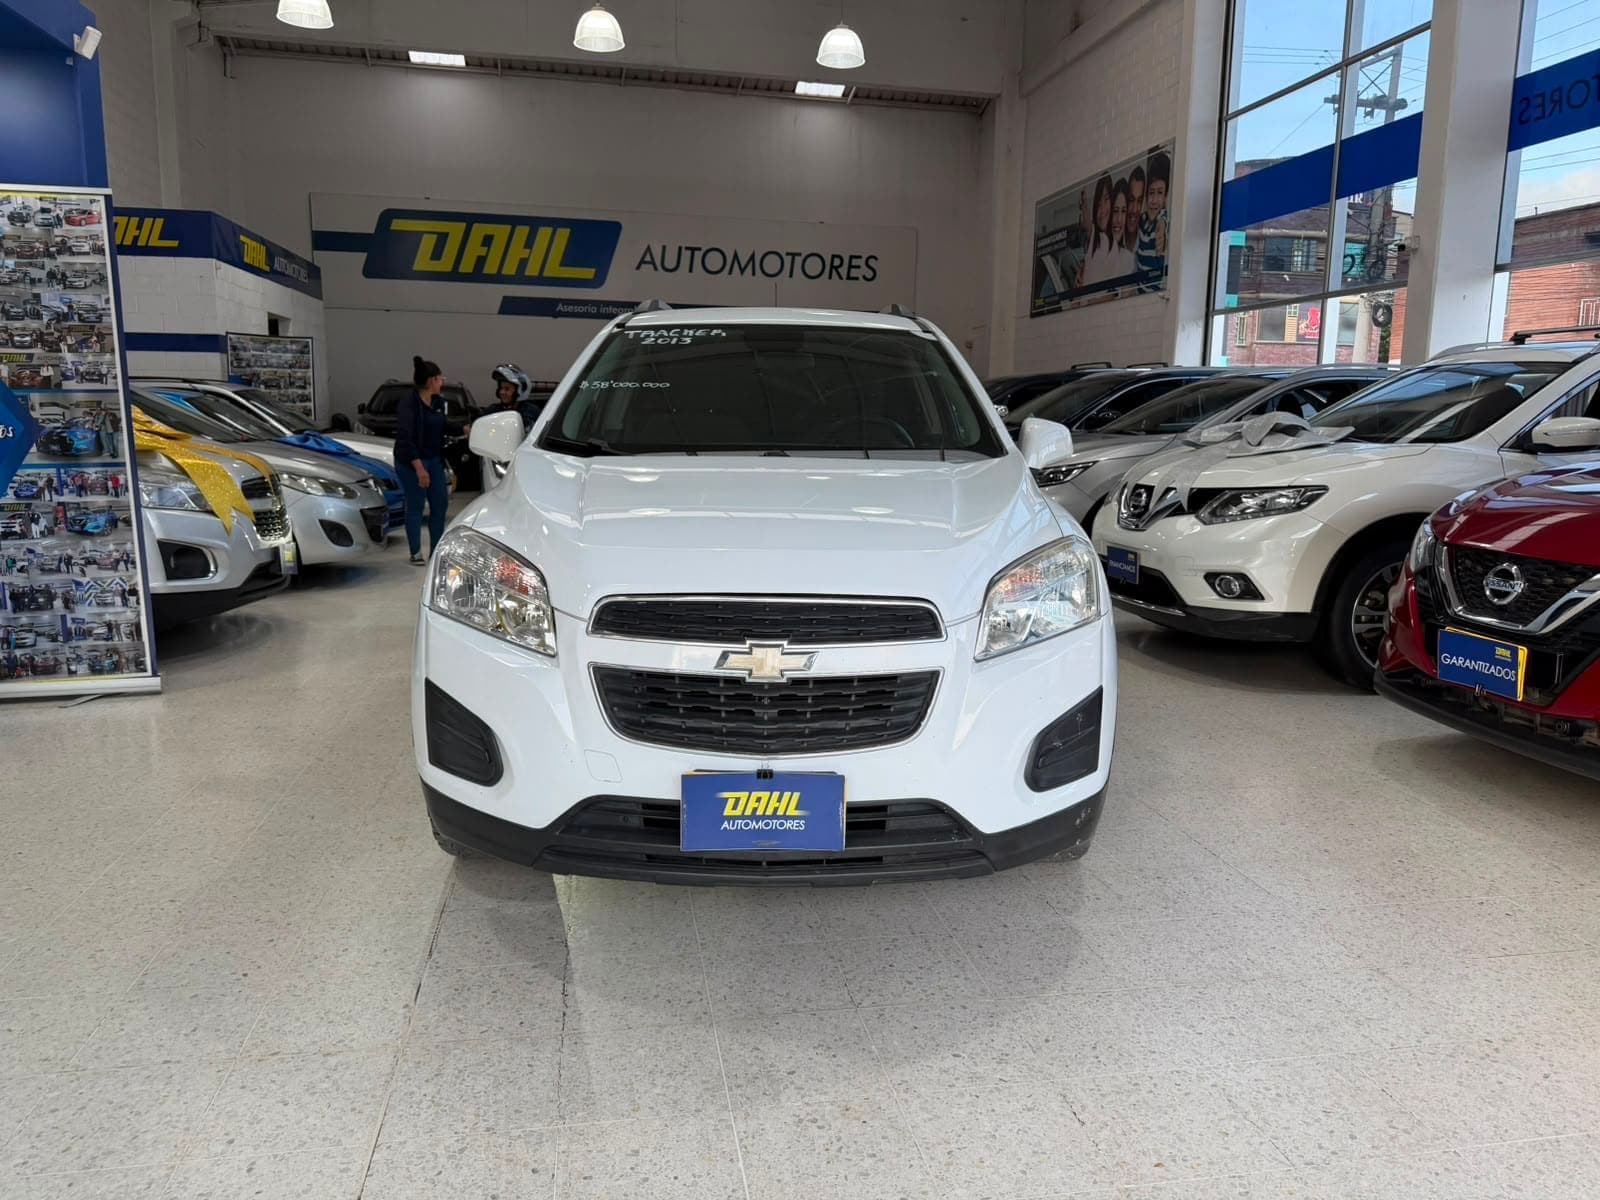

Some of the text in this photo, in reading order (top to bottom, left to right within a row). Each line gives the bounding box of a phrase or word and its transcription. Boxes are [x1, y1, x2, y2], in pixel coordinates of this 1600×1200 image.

[240, 234, 271, 273] DAHL
[391, 219, 878, 282] DAHL AUTOMOTORES
[640, 337, 694, 345] 2013
[1441, 653, 1516, 681] GARANTIZADOS
[715, 791, 809, 816] DAHL
[720, 820, 805, 831] AUTOMOTORES
